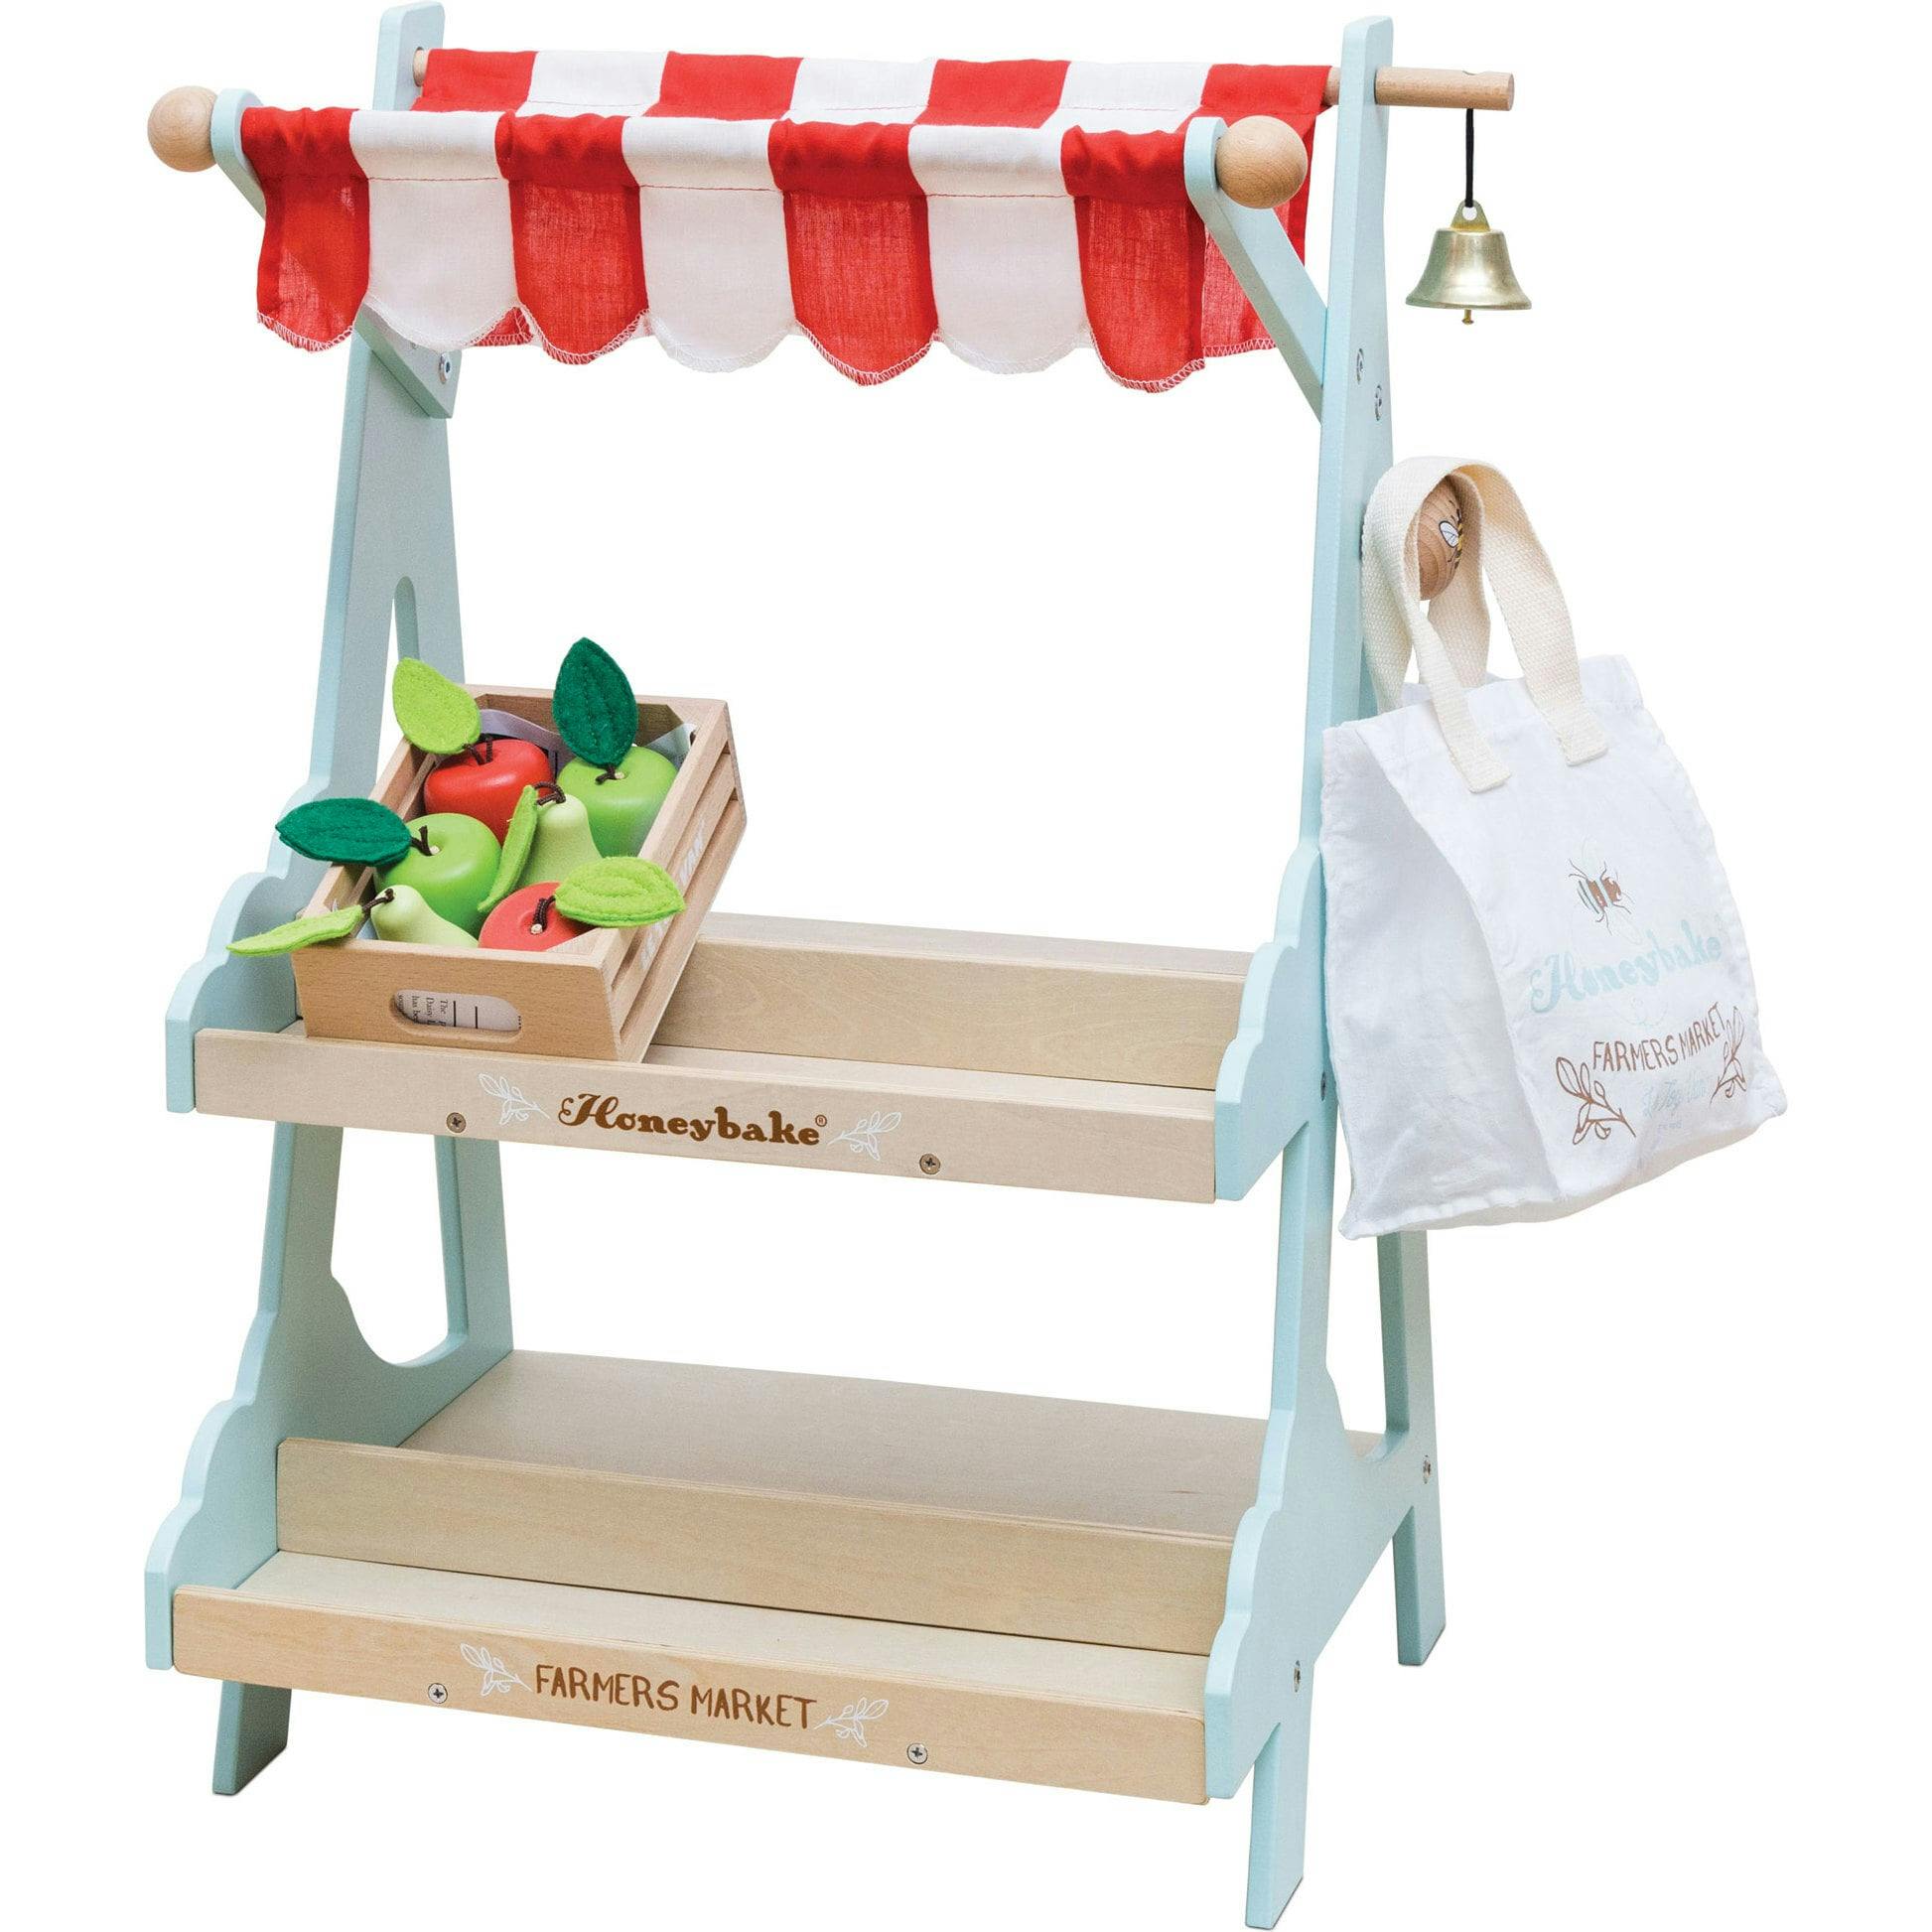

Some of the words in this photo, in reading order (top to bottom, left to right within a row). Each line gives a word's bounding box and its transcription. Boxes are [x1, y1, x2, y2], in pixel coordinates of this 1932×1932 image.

[1530, 919, 1723, 1013] Honeybake
[440, 999, 449, 1015] The
[1592, 1035, 1678, 1072] FARMERS
[1679, 1002, 1725, 1060] MARKET
[536, 1664, 680, 1712] FARMERS
[691, 1685, 817, 1729] MARKET
